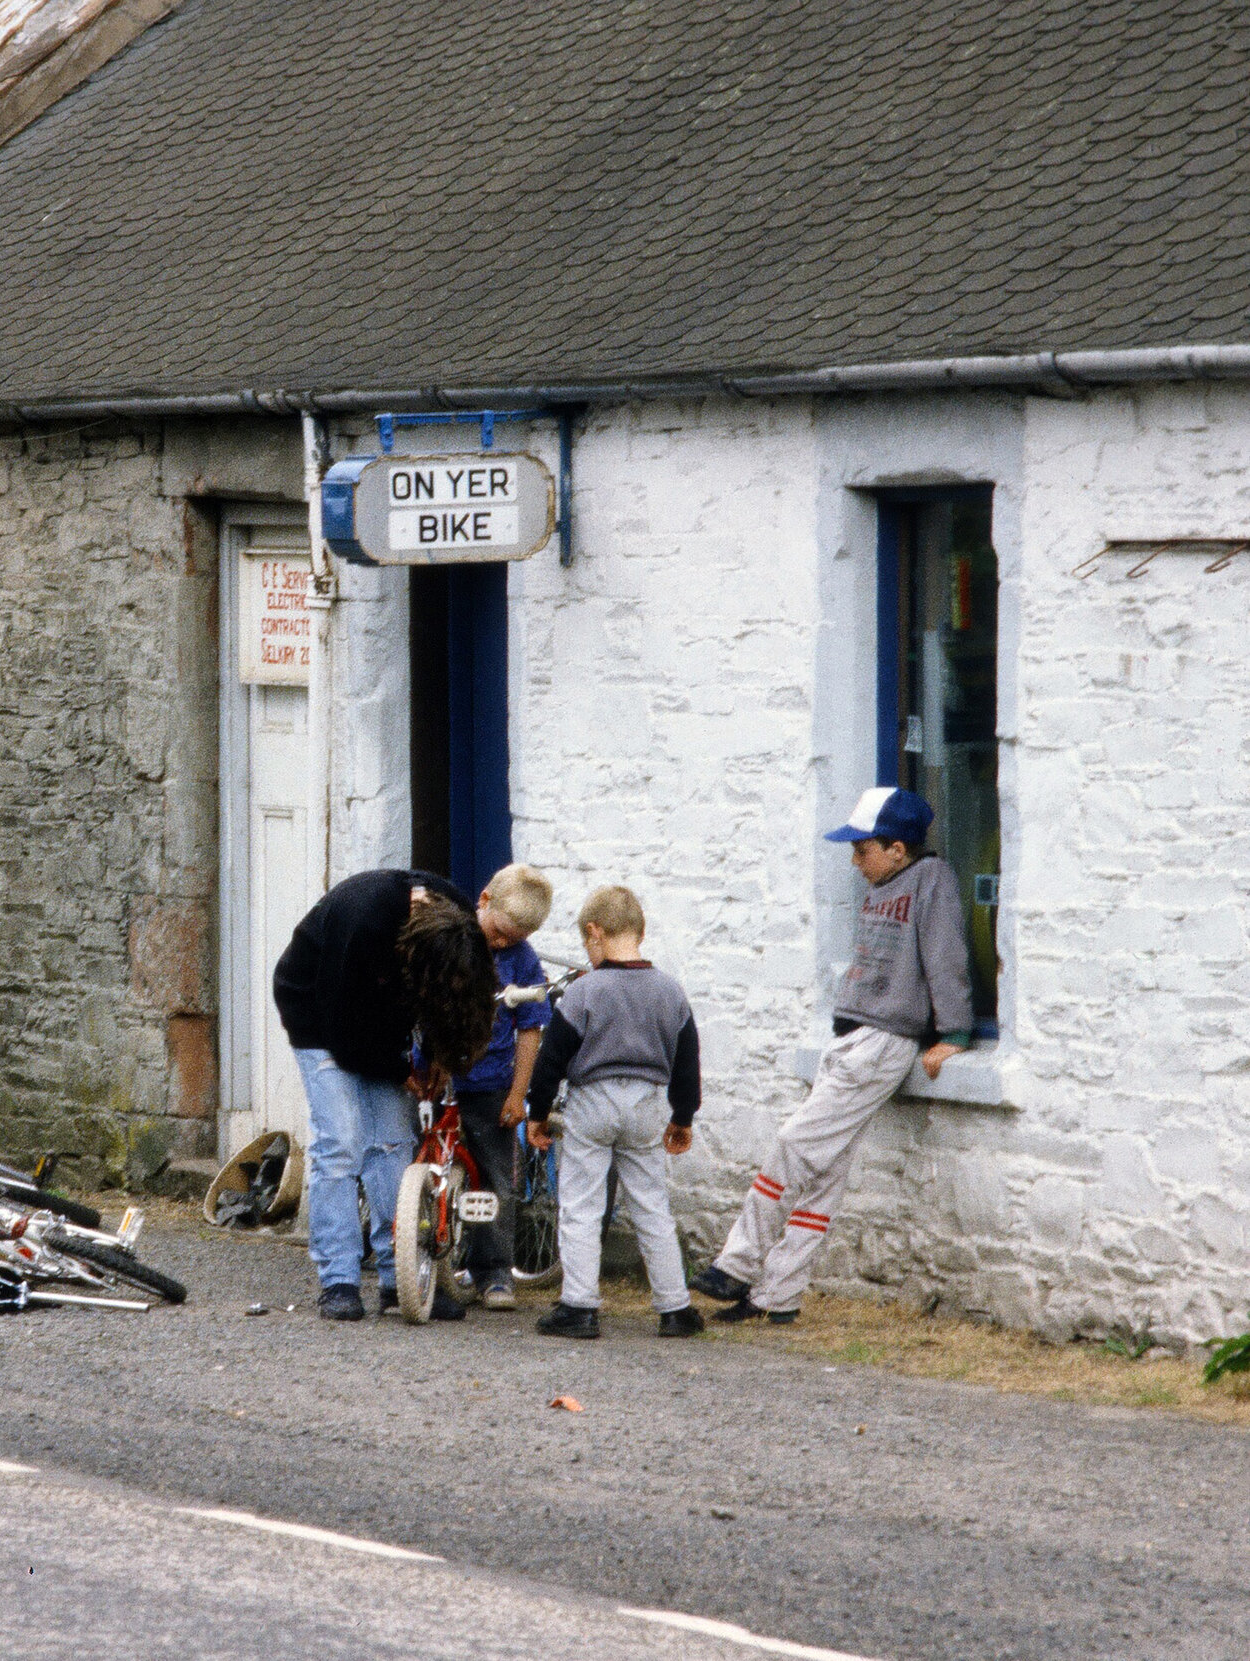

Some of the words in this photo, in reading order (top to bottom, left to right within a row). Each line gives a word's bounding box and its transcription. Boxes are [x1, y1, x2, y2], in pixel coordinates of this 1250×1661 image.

[392, 470, 434, 500] ON
[446, 468, 509, 498] YER
[418, 511, 492, 544] BIKE
[261, 562, 269, 588] C
